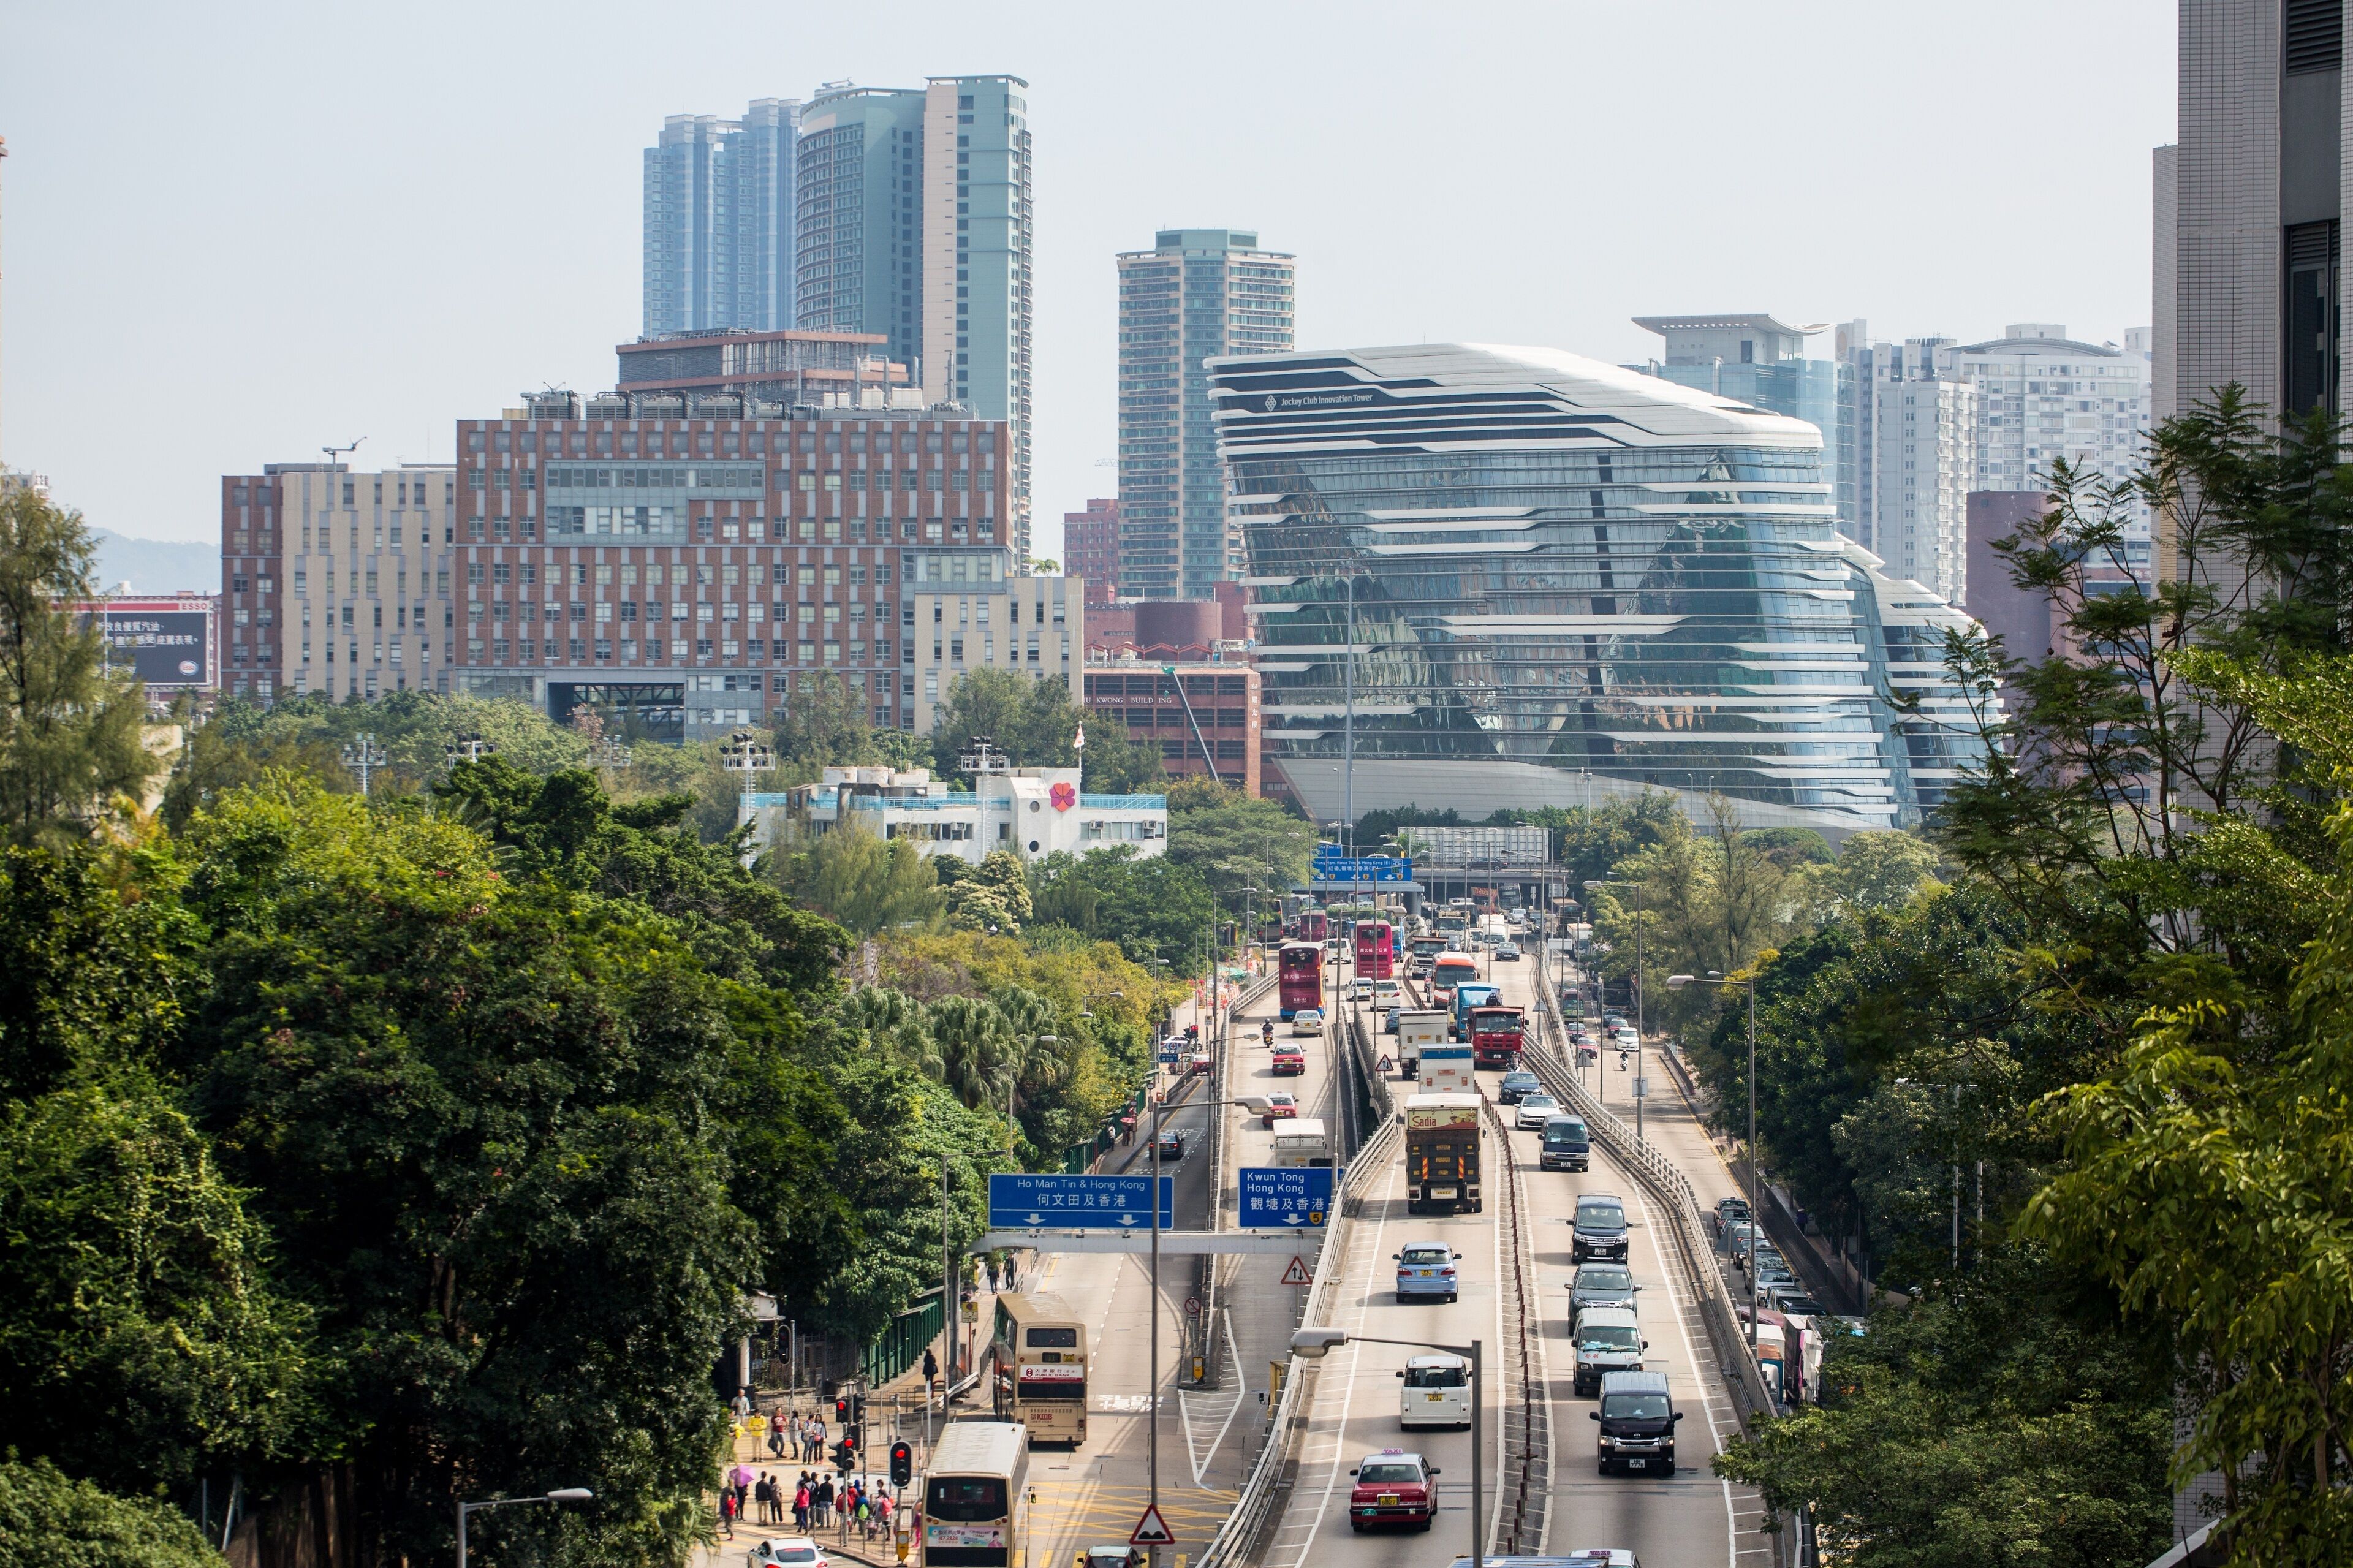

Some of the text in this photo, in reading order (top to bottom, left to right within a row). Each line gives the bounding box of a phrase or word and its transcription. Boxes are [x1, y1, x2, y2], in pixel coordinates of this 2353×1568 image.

[1281, 397, 1302, 407] Jockey
[1319, 395, 1352, 404] Innovation
[1412, 1116, 1436, 1127] Sadia
[1247, 1172, 1304, 1183] Kwun Tong
[1017, 1179, 1145, 1191] Ho Man Tin & Hong Kong
[1247, 1183, 1304, 1194] Hong Kong
[1037, 1193, 1126, 1207] 何文田及香港
[1251, 1197, 1324, 1210] 觀塘及香港
[1313, 1214, 1320, 1222] 5
